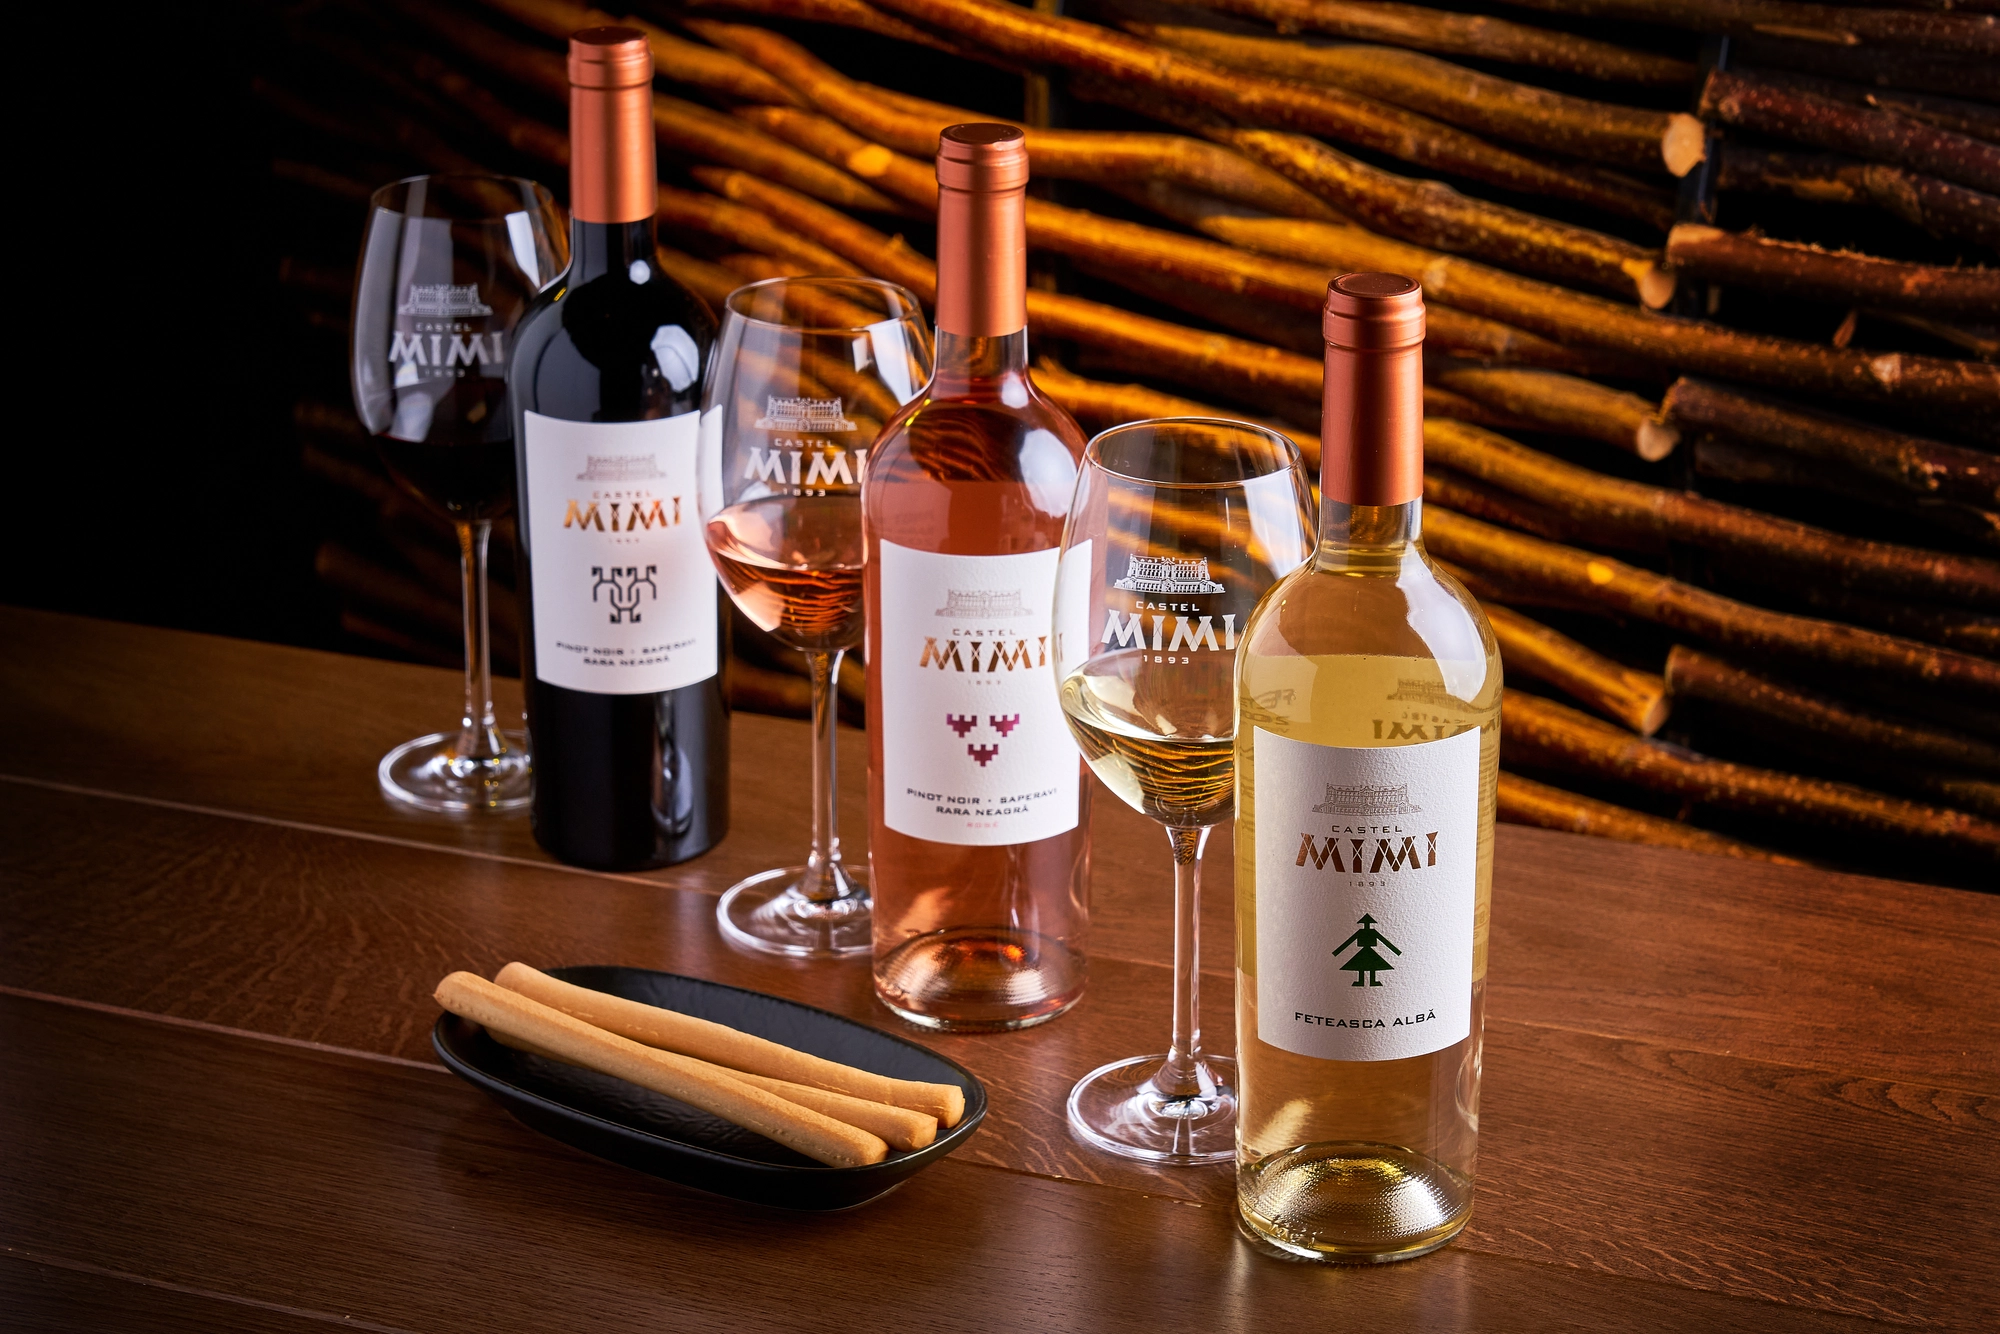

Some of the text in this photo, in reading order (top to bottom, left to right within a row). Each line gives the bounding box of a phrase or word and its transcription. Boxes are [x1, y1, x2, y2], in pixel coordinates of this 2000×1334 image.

[415, 322, 472, 332] CASTEL
[388, 330, 504, 366] MIMI
[774, 437, 835, 448] CASTEL
[744, 446, 868, 485] MIMI
[783, 487, 826, 497] 1893
[563, 496, 681, 532] MIMI
[1135, 600, 1201, 612] CASTEL
[952, 628, 1017, 638] CASTEL
[1100, 608, 1237, 652] MIMI
[919, 635, 1048, 673] MIMI
[1143, 654, 1190, 665] 1893
[906, 787, 1058, 805] PINOT NOIR SAPERAVI
[935, 805, 971, 816] RARA
[1331, 825, 1403, 834] CASTEL
[1295, 831, 1439, 874] MIMI
[1349, 880, 1386, 888] 1893
[1294, 1008, 1436, 1029] FETEASCA ALBĂ
